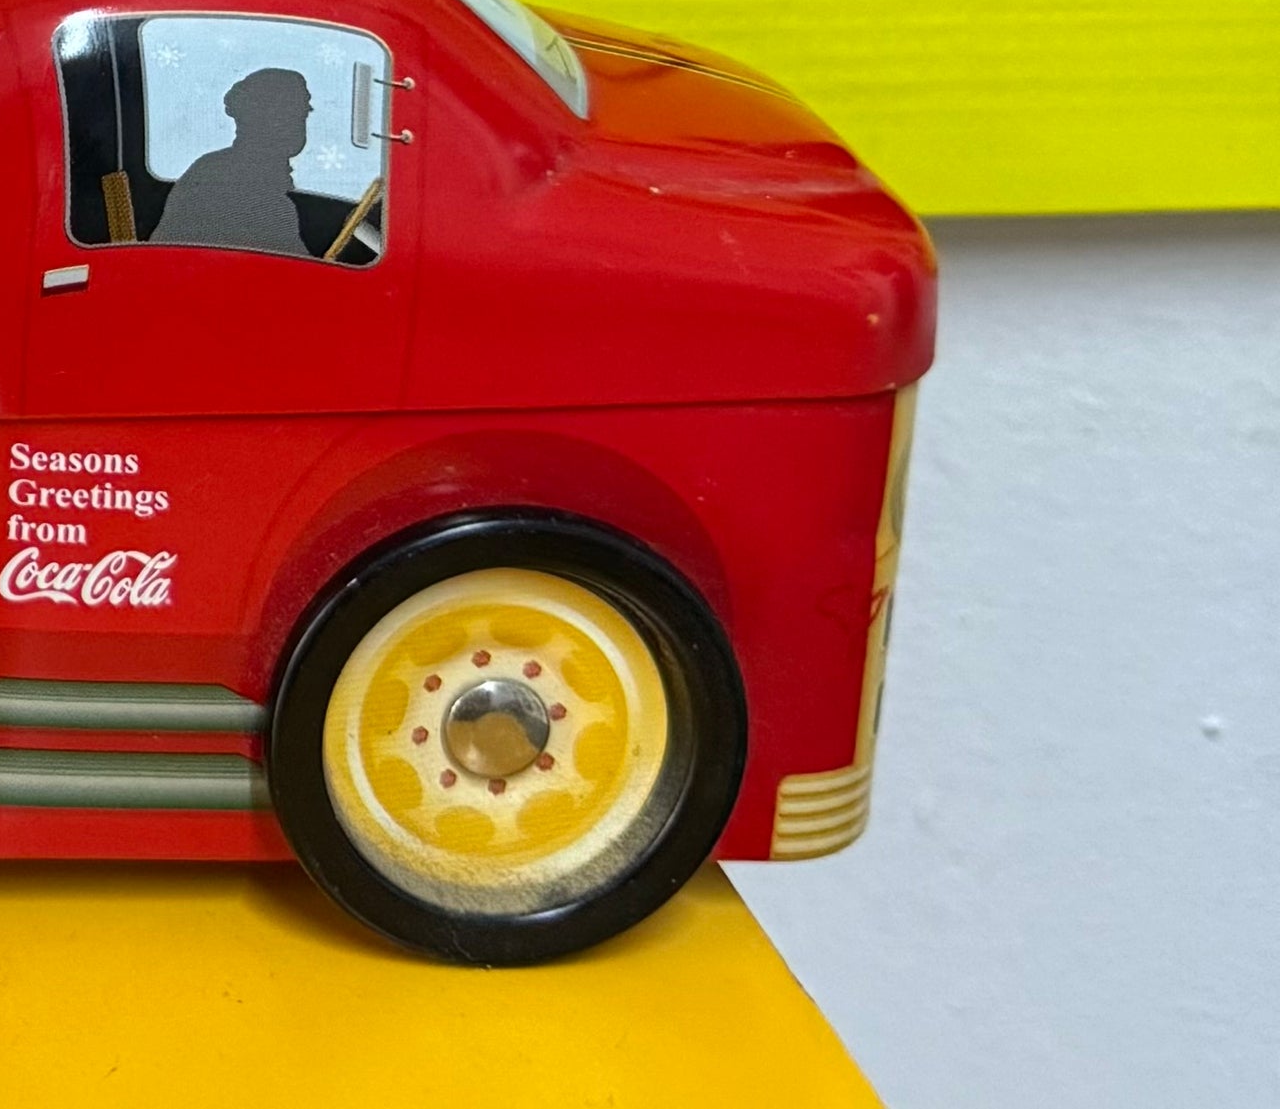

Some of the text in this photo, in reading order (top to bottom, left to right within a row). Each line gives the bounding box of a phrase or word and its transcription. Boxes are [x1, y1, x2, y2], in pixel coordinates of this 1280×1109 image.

[9, 442, 140, 474] Seasons
[7, 478, 170, 518] Greetings
[6, 513, 88, 544] from
